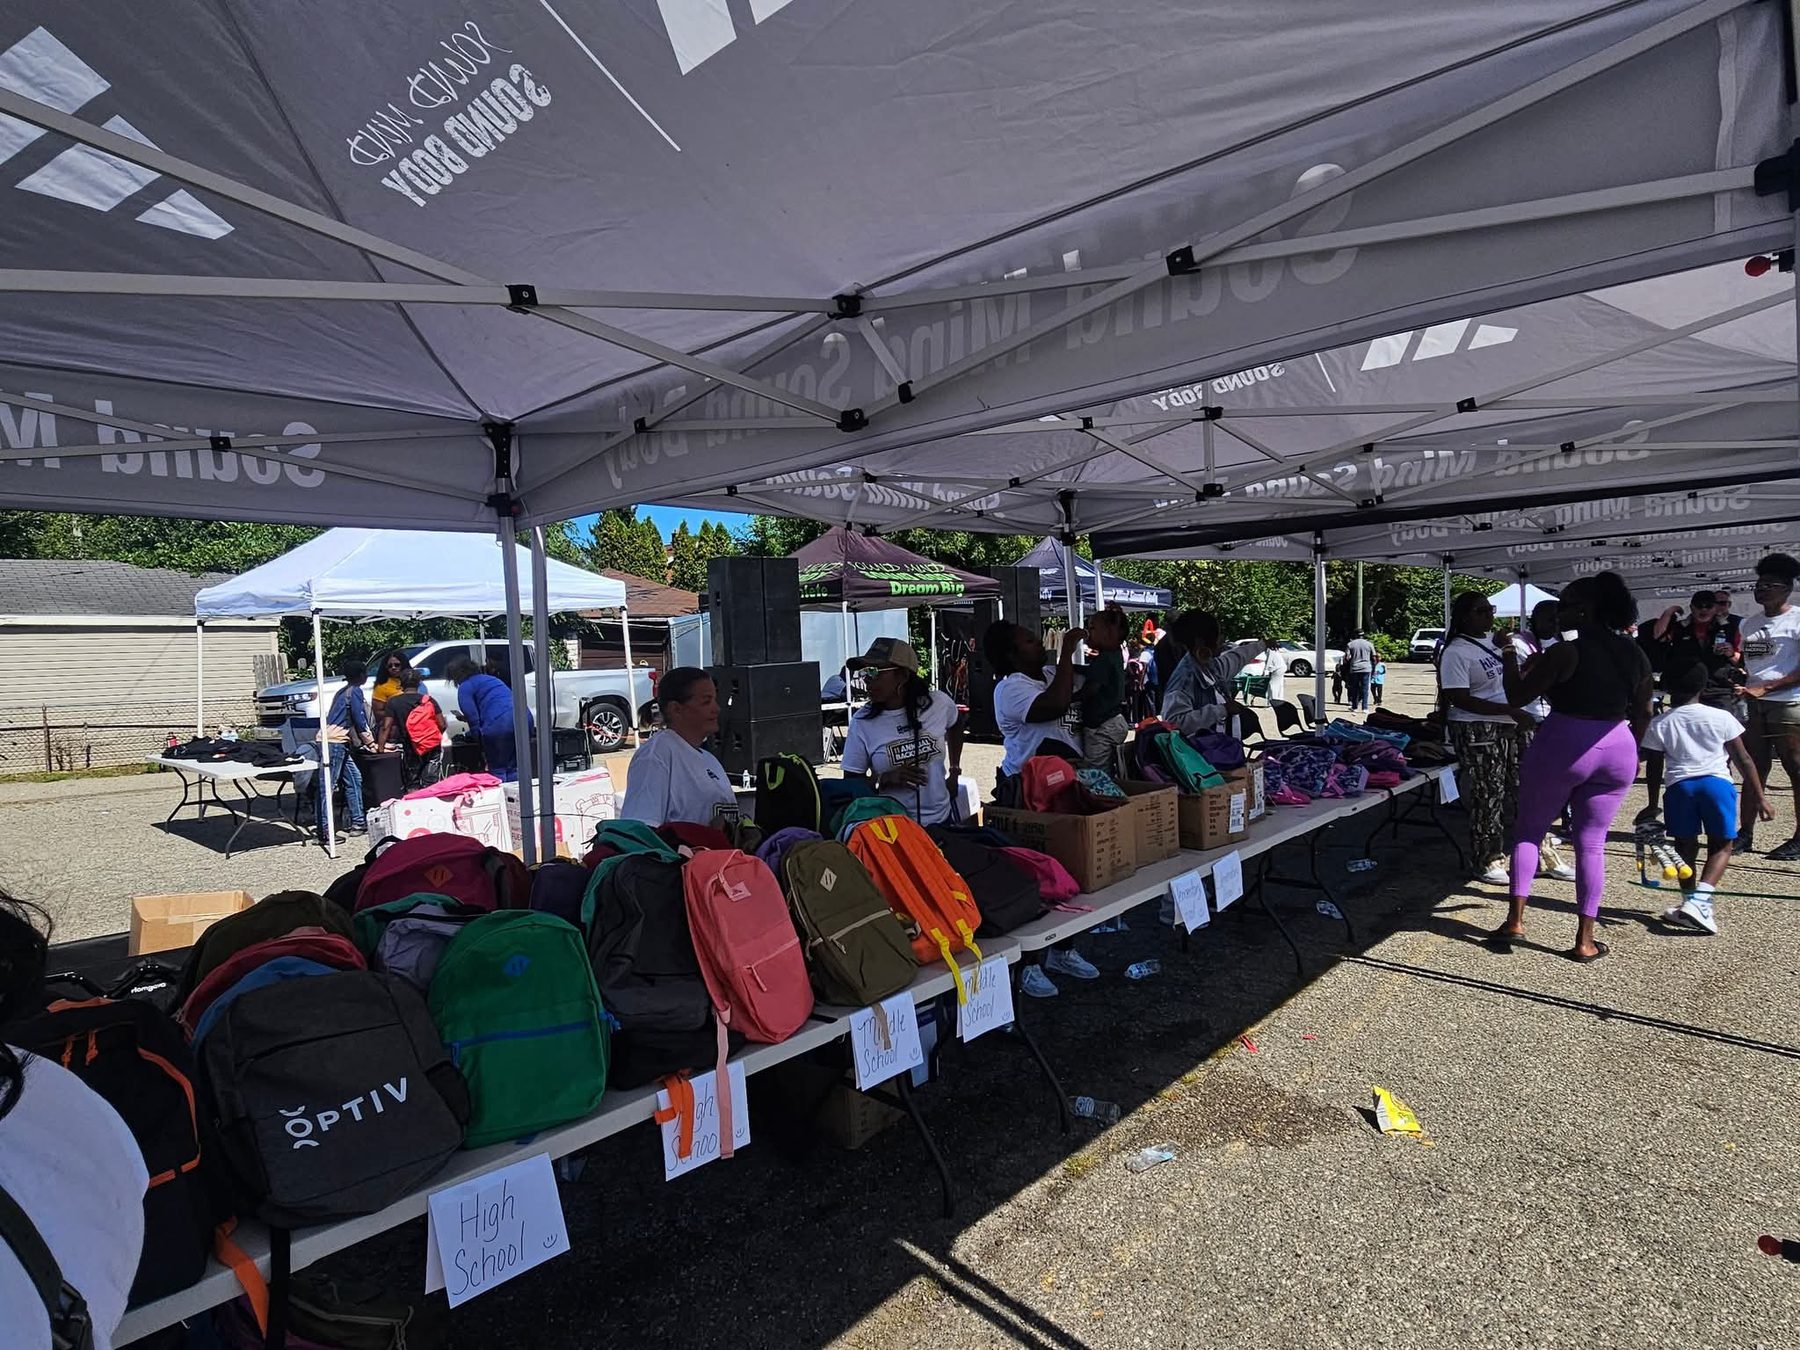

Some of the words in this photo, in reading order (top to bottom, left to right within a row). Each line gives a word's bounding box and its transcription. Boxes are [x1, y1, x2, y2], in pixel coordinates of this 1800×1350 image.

[889, 580, 940, 596] Dream
[940, 581, 965, 597] Big
[895, 745, 933, 761] BACKACK
[900, 737, 931, 753] ANNAL
[858, 1008, 906, 1049] Midle
[965, 991, 995, 1028] School
[862, 1037, 899, 1079] School
[280, 1077, 408, 1141] OPTIV
[460, 1178, 515, 1243] High
[451, 1220, 526, 1296] School
